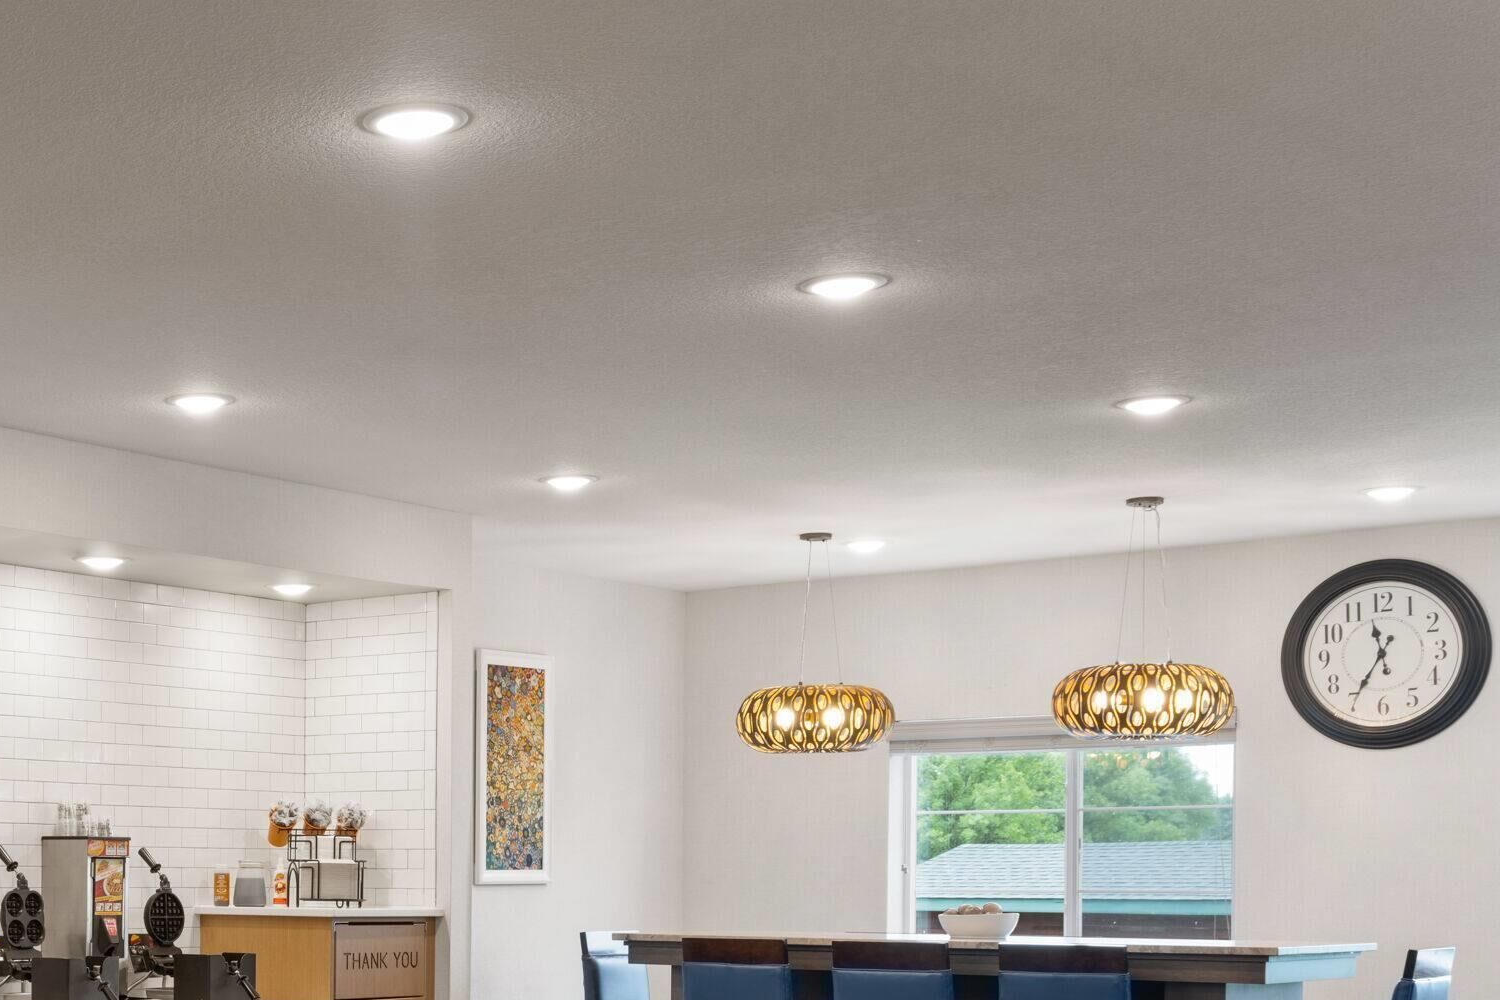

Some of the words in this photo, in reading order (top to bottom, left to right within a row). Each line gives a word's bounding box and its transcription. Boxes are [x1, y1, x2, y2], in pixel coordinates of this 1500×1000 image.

[1345, 601, 1362, 623] 11
[1373, 591, 1393, 613] 12
[1406, 595, 1414, 617] 1
[1425, 611, 1440, 633] 2
[1323, 622, 1343, 645] 10
[1318, 650, 1331, 670] 9
[1434, 639, 1448, 661] 3
[1327, 673, 1340, 695] 8
[1426, 664, 1441, 686] 4
[1377, 695, 1390, 716] 6
[1406, 687, 1419, 708] 5
[343, 951, 388, 970] THANK
[393, 951, 419, 969] YOU
